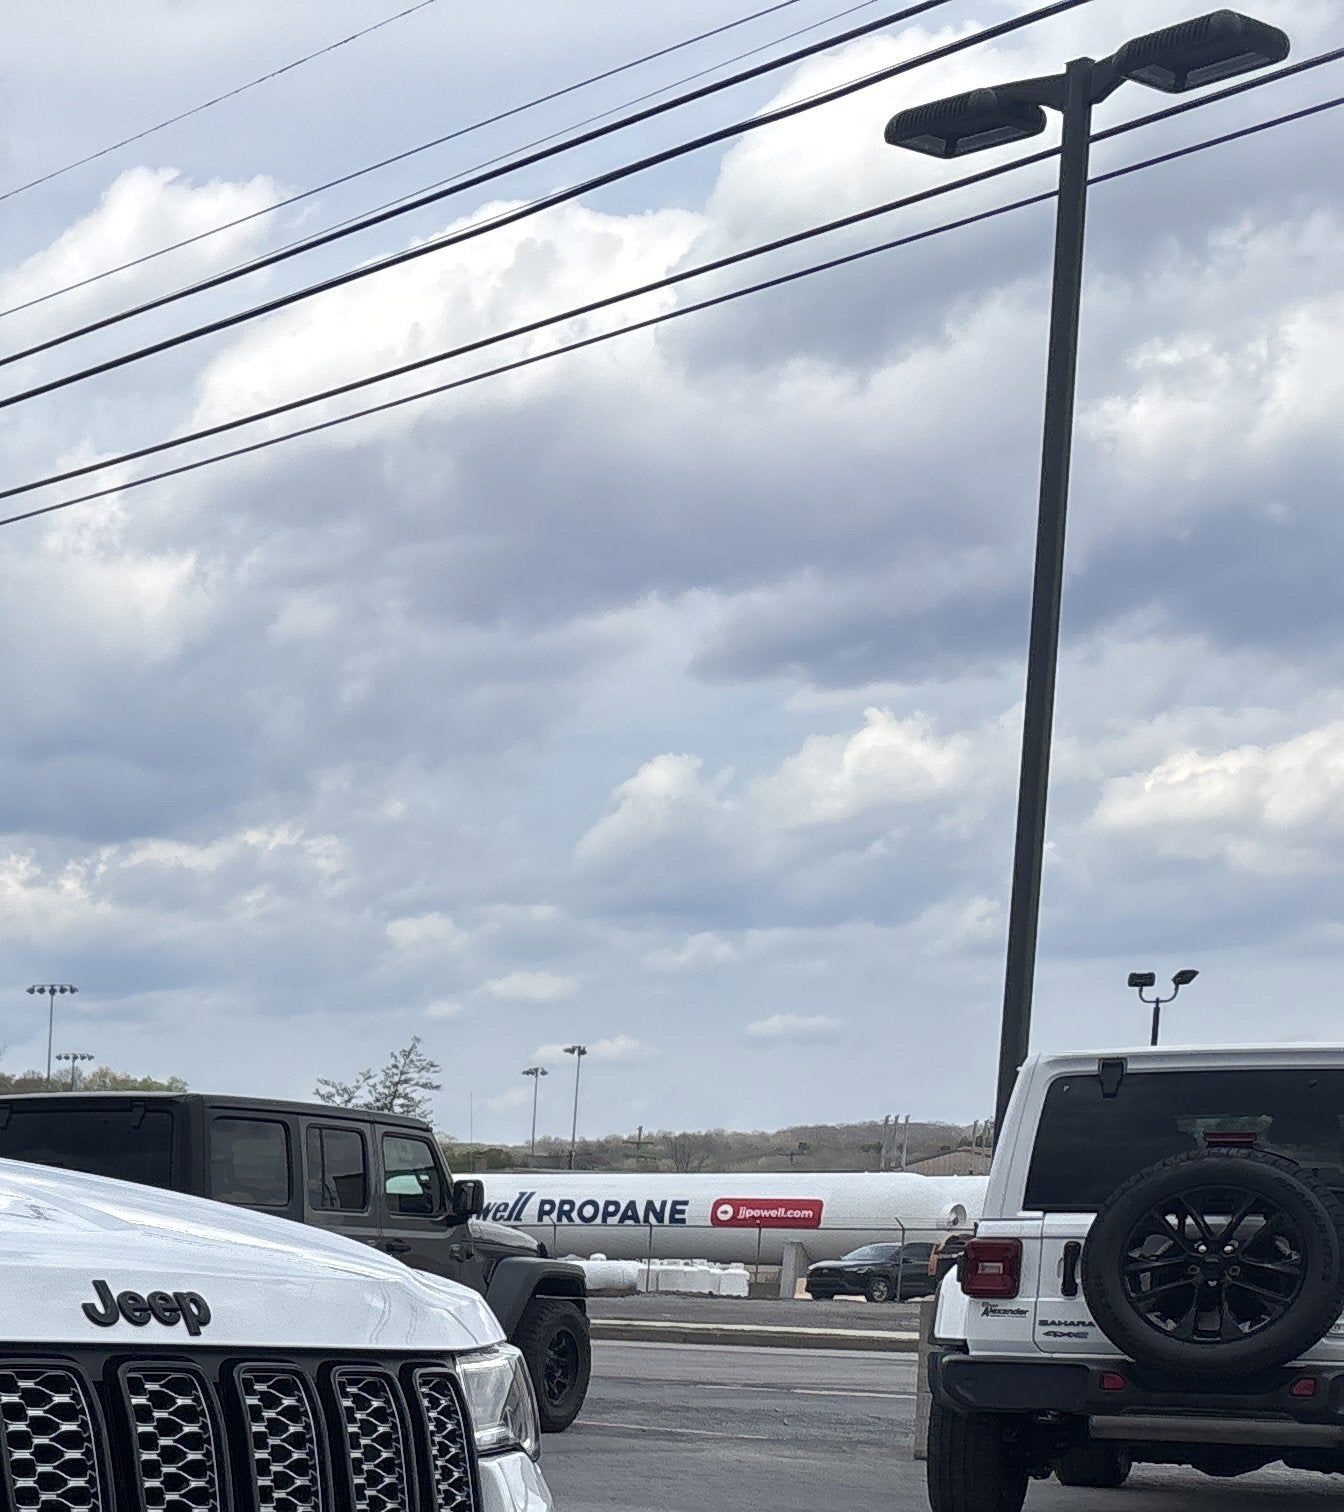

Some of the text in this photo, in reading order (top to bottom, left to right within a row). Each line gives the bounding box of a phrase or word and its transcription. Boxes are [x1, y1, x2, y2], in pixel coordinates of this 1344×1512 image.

[475, 1191, 690, 1224] well PROPANE
[81, 1280, 212, 1337] Jeep
